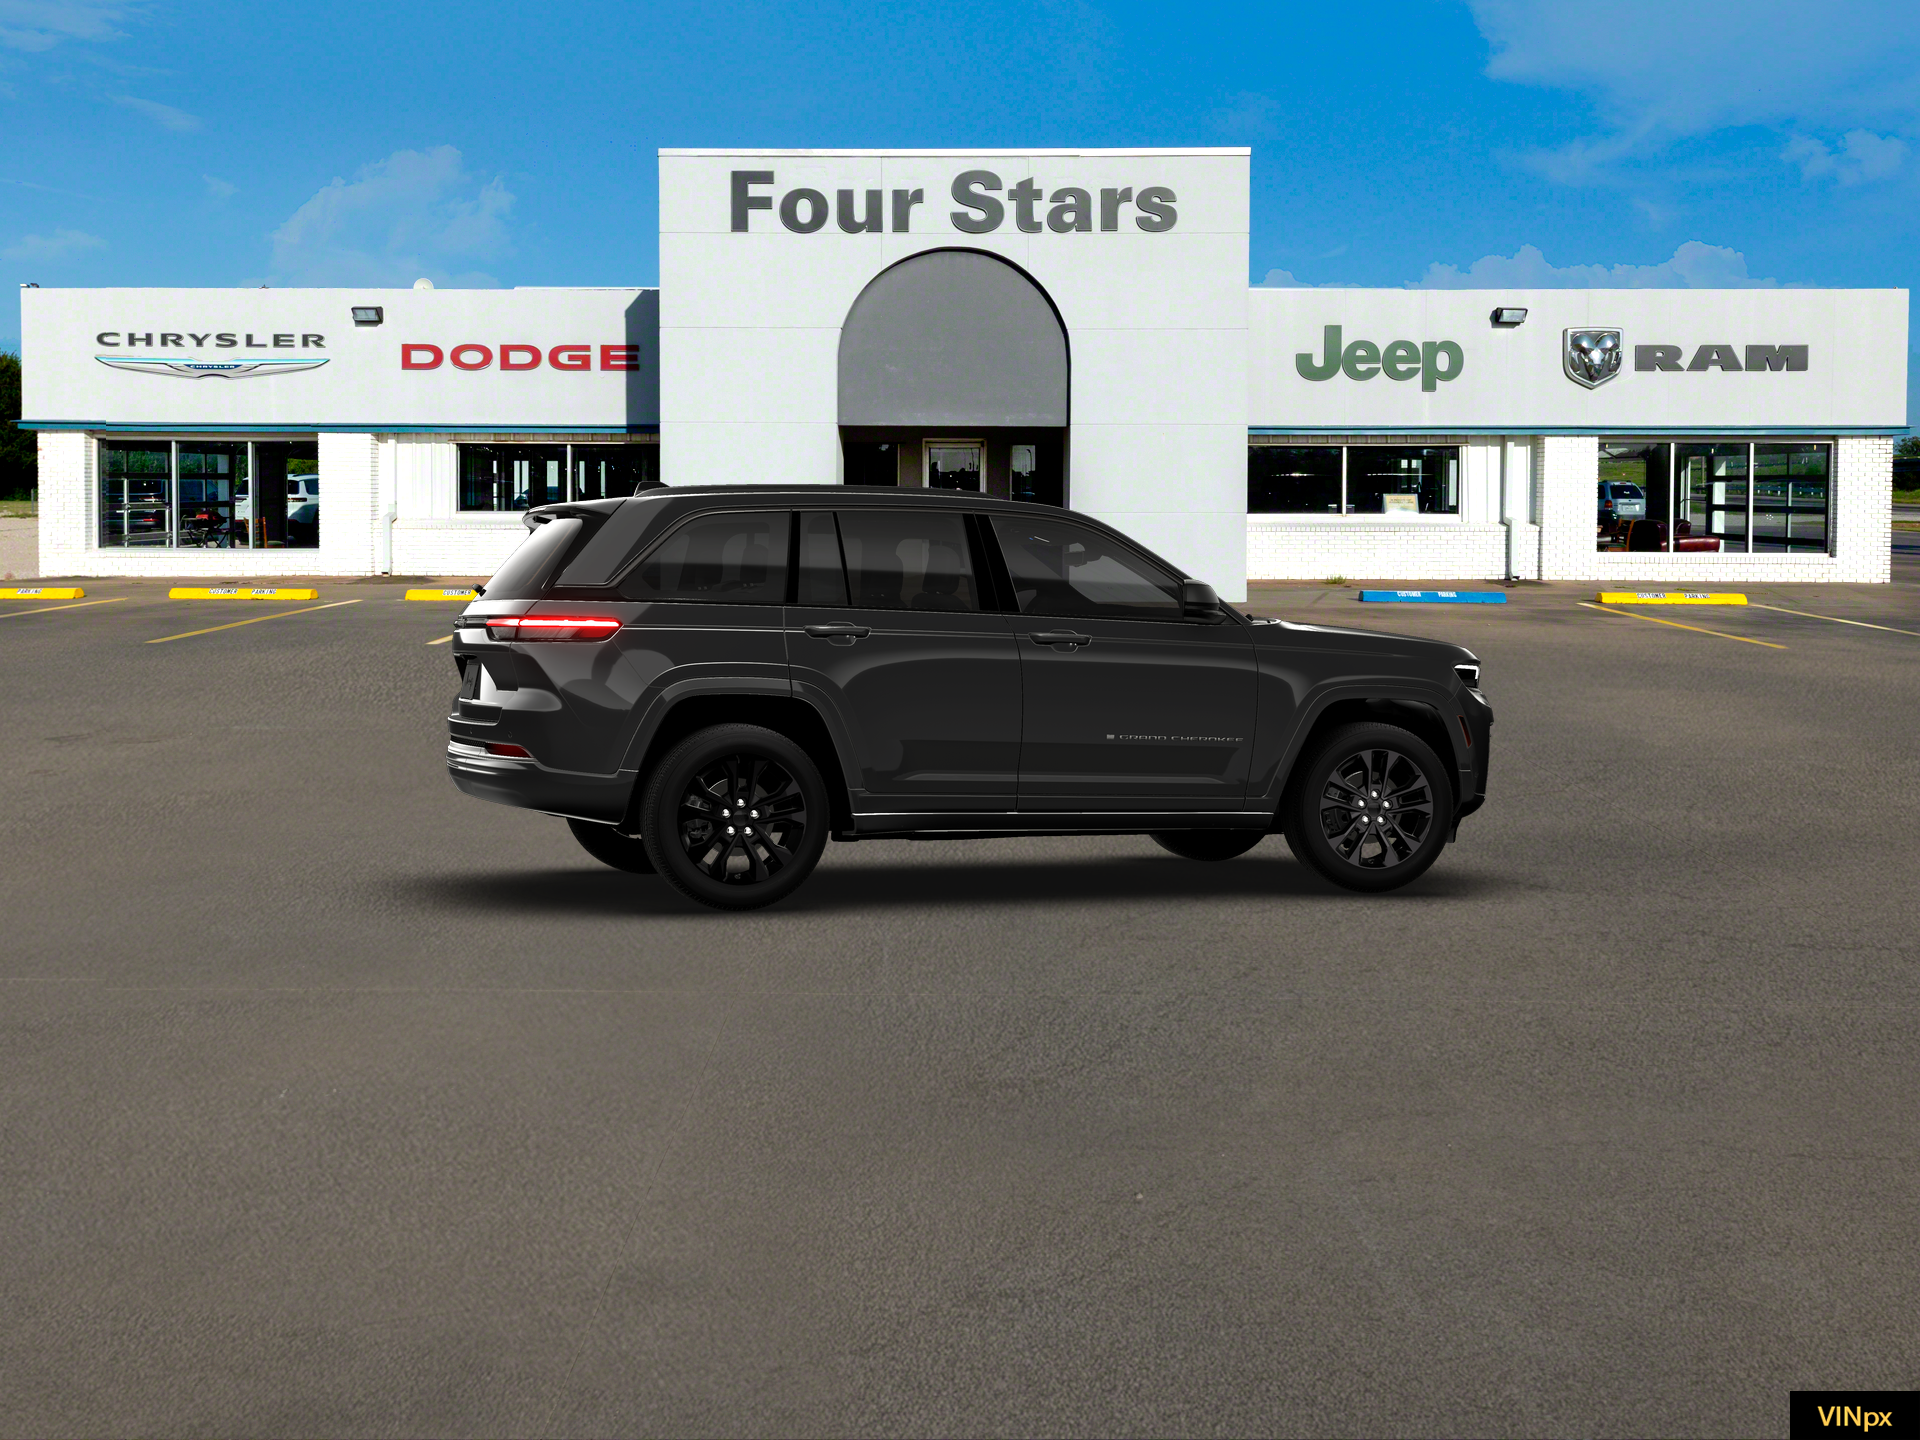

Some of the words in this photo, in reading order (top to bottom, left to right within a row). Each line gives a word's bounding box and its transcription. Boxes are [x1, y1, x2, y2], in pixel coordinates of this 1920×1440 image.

[731, 170, 924, 233] Four
[950, 169, 1178, 234] Stars
[96, 332, 327, 348] CHRYSLER
[400, 343, 641, 372] DODGE
[1295, 324, 1465, 393] Jeep
[1634, 343, 1810, 372] RAM
